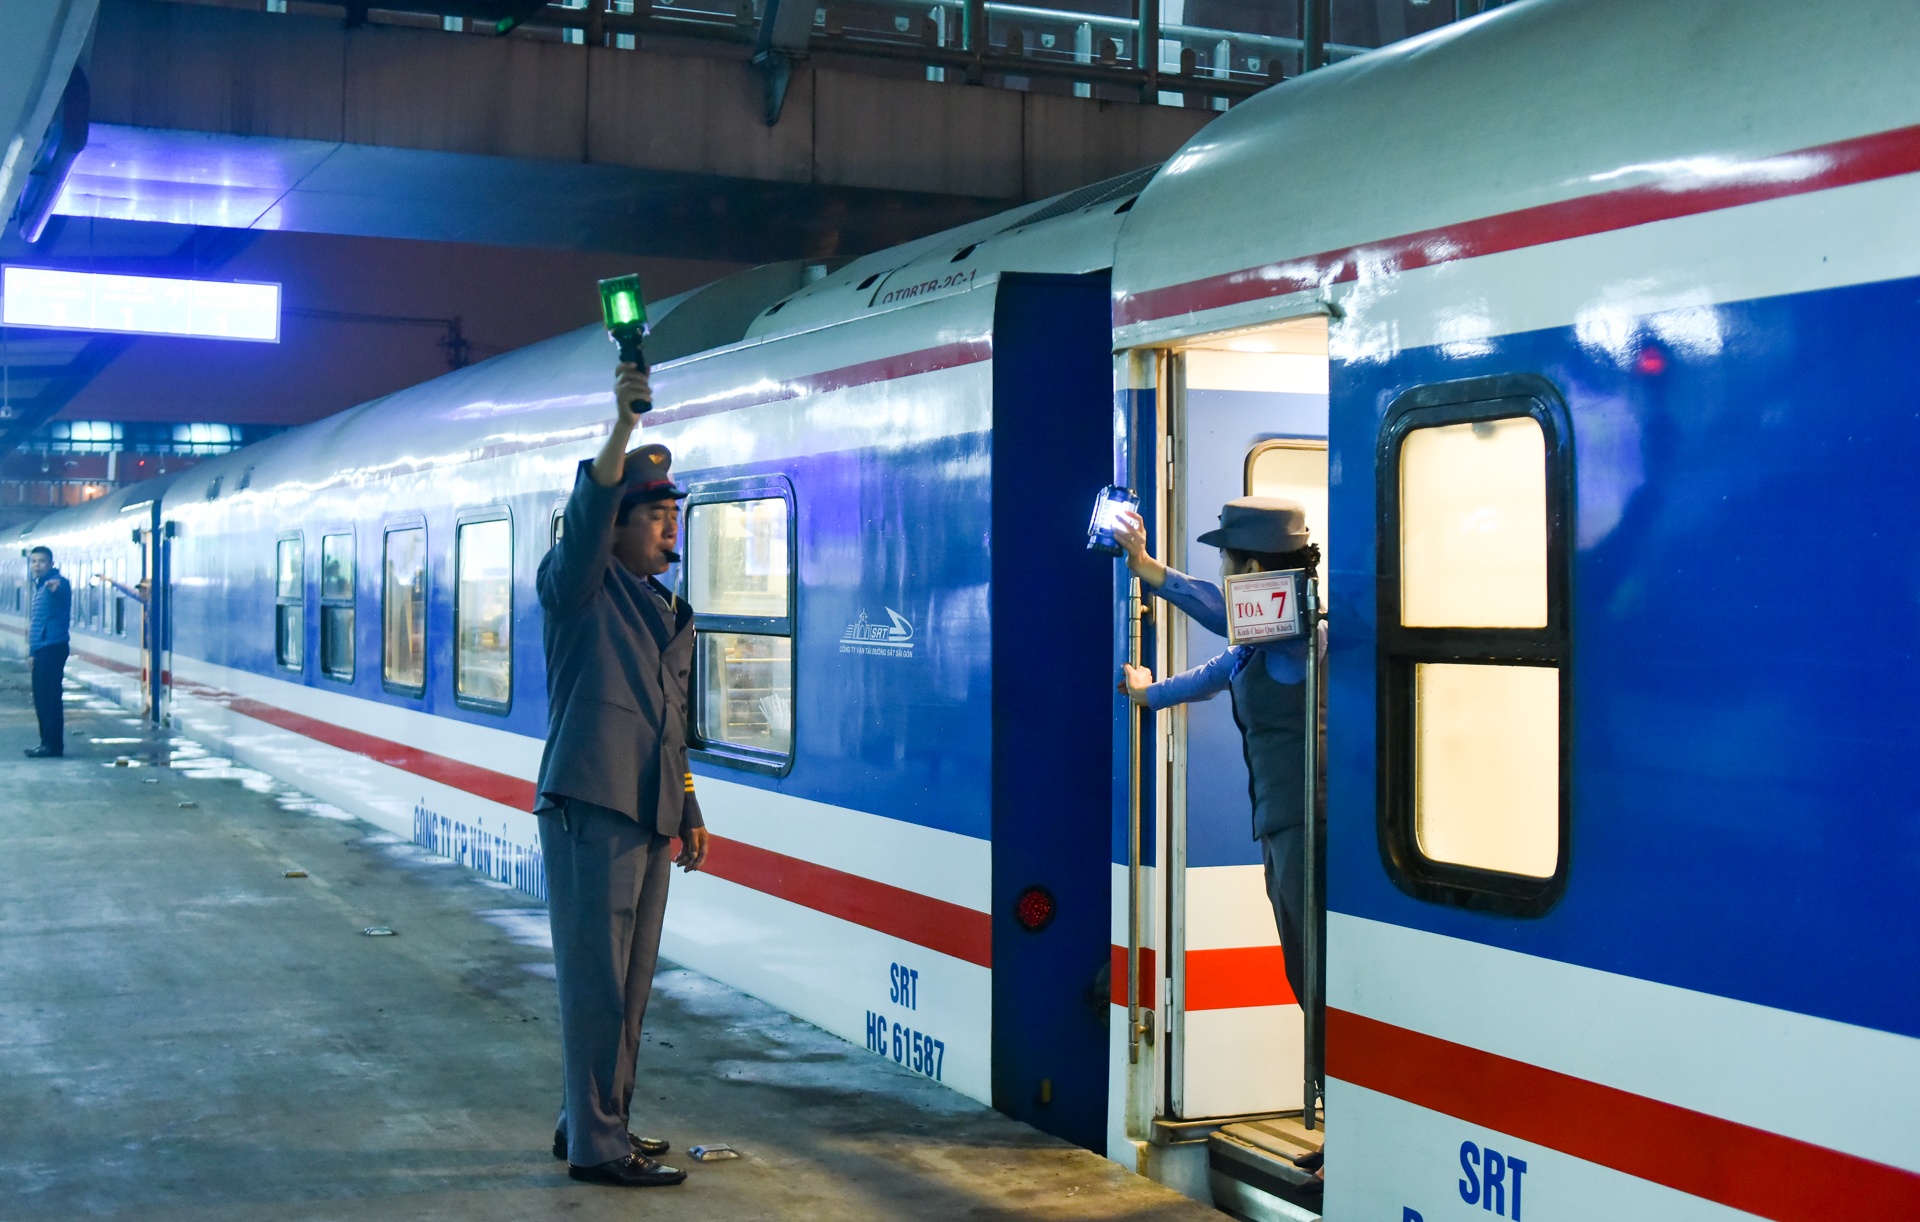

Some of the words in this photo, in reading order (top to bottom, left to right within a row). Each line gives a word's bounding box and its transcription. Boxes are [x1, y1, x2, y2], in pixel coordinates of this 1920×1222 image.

[871, 627, 889, 639] SRT
[1235, 601, 1264, 619] TOA
[1271, 591, 1287, 619] 7
[414, 796, 438, 853] CÔNG
[441, 815, 452, 858] TY
[455, 820, 467, 864] CP
[494, 822, 512, 886] TẢI
[890, 962, 918, 1011] SRT
[866, 1010, 887, 1056] HC
[893, 1022, 945, 1081] 61587
[1458, 1140, 1527, 1222] SRT
